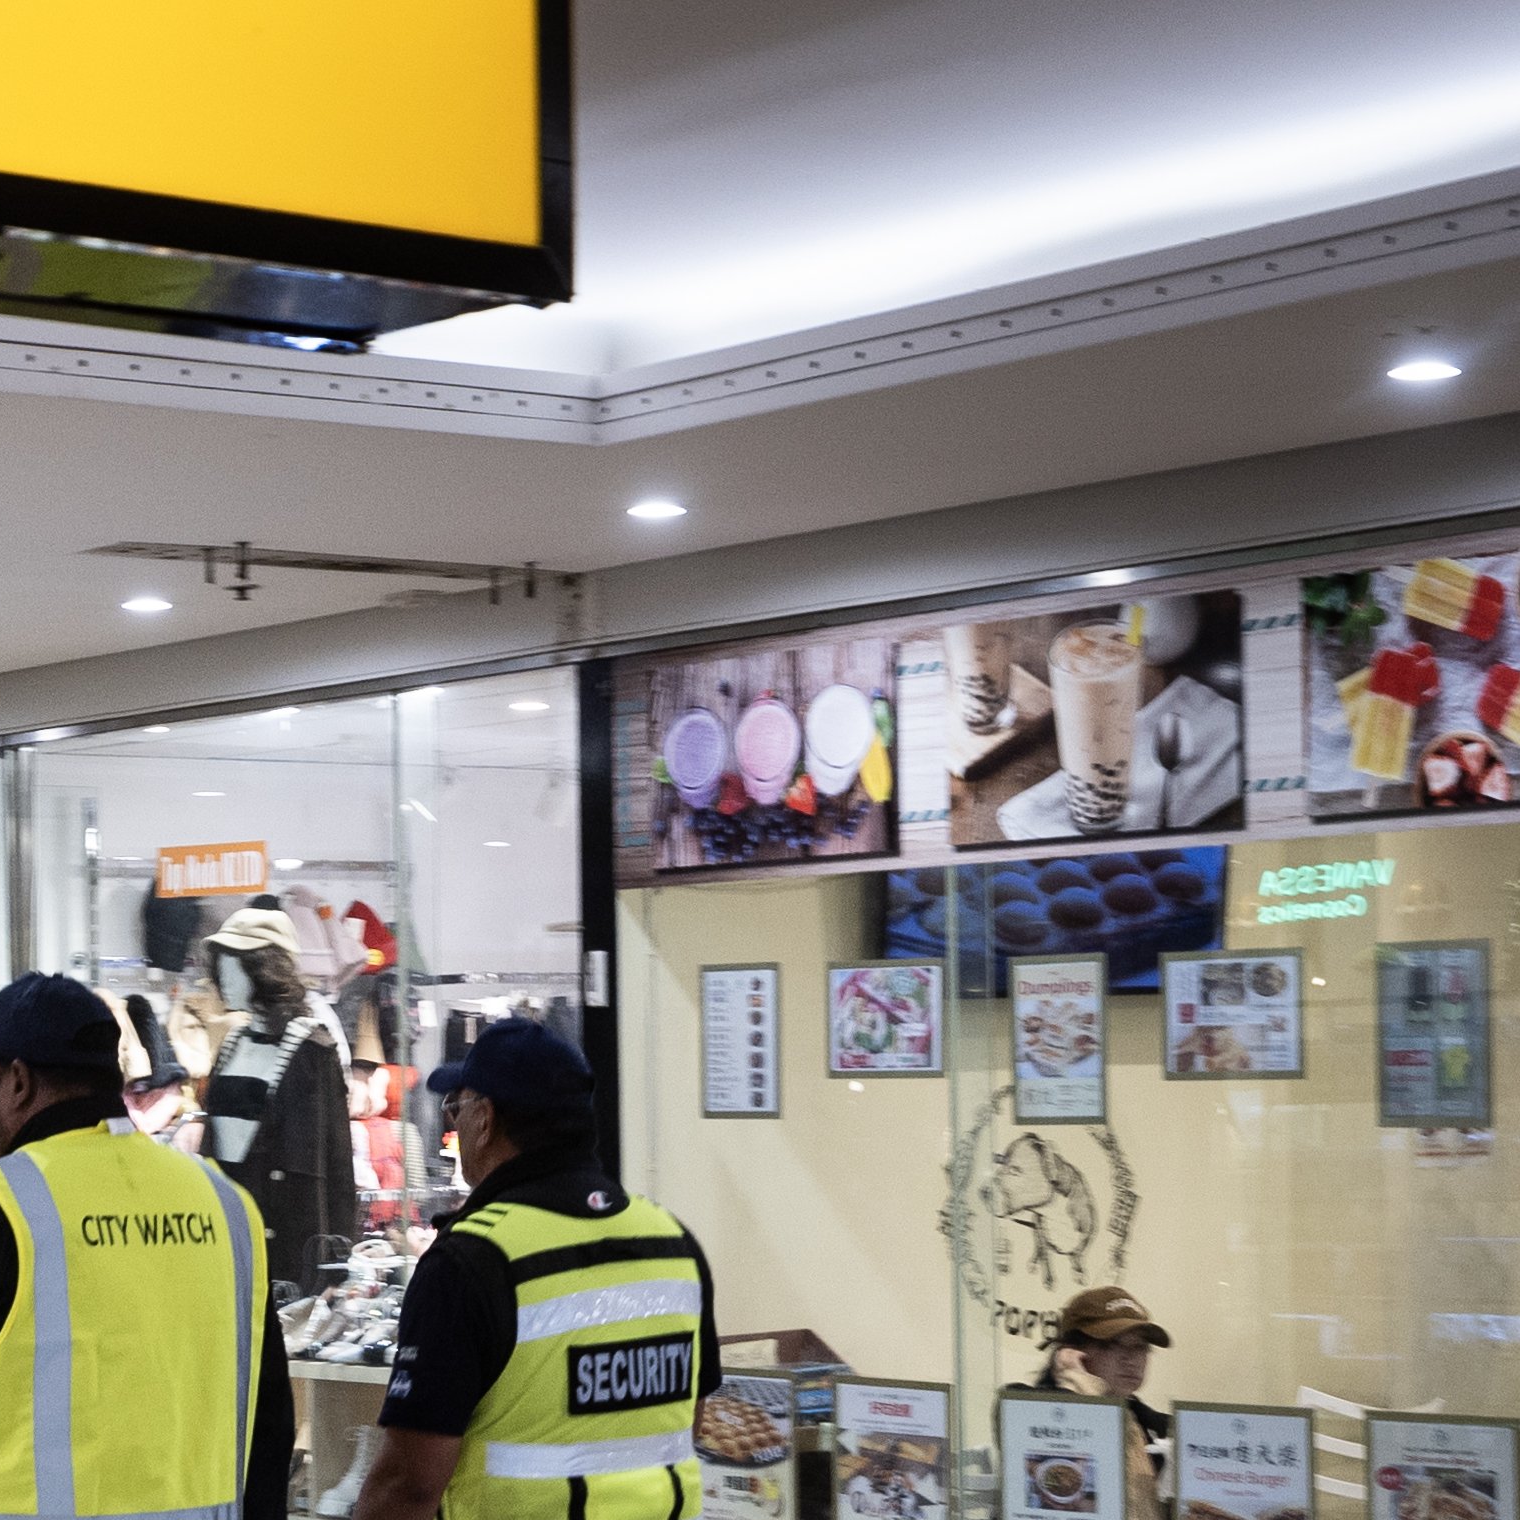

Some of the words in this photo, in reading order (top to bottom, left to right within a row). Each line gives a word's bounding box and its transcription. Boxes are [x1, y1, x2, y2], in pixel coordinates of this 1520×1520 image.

[81, 1213, 129, 1247] CITY
[134, 1212, 217, 1246] WATCH
[576, 1342, 693, 1405] SECURITY
